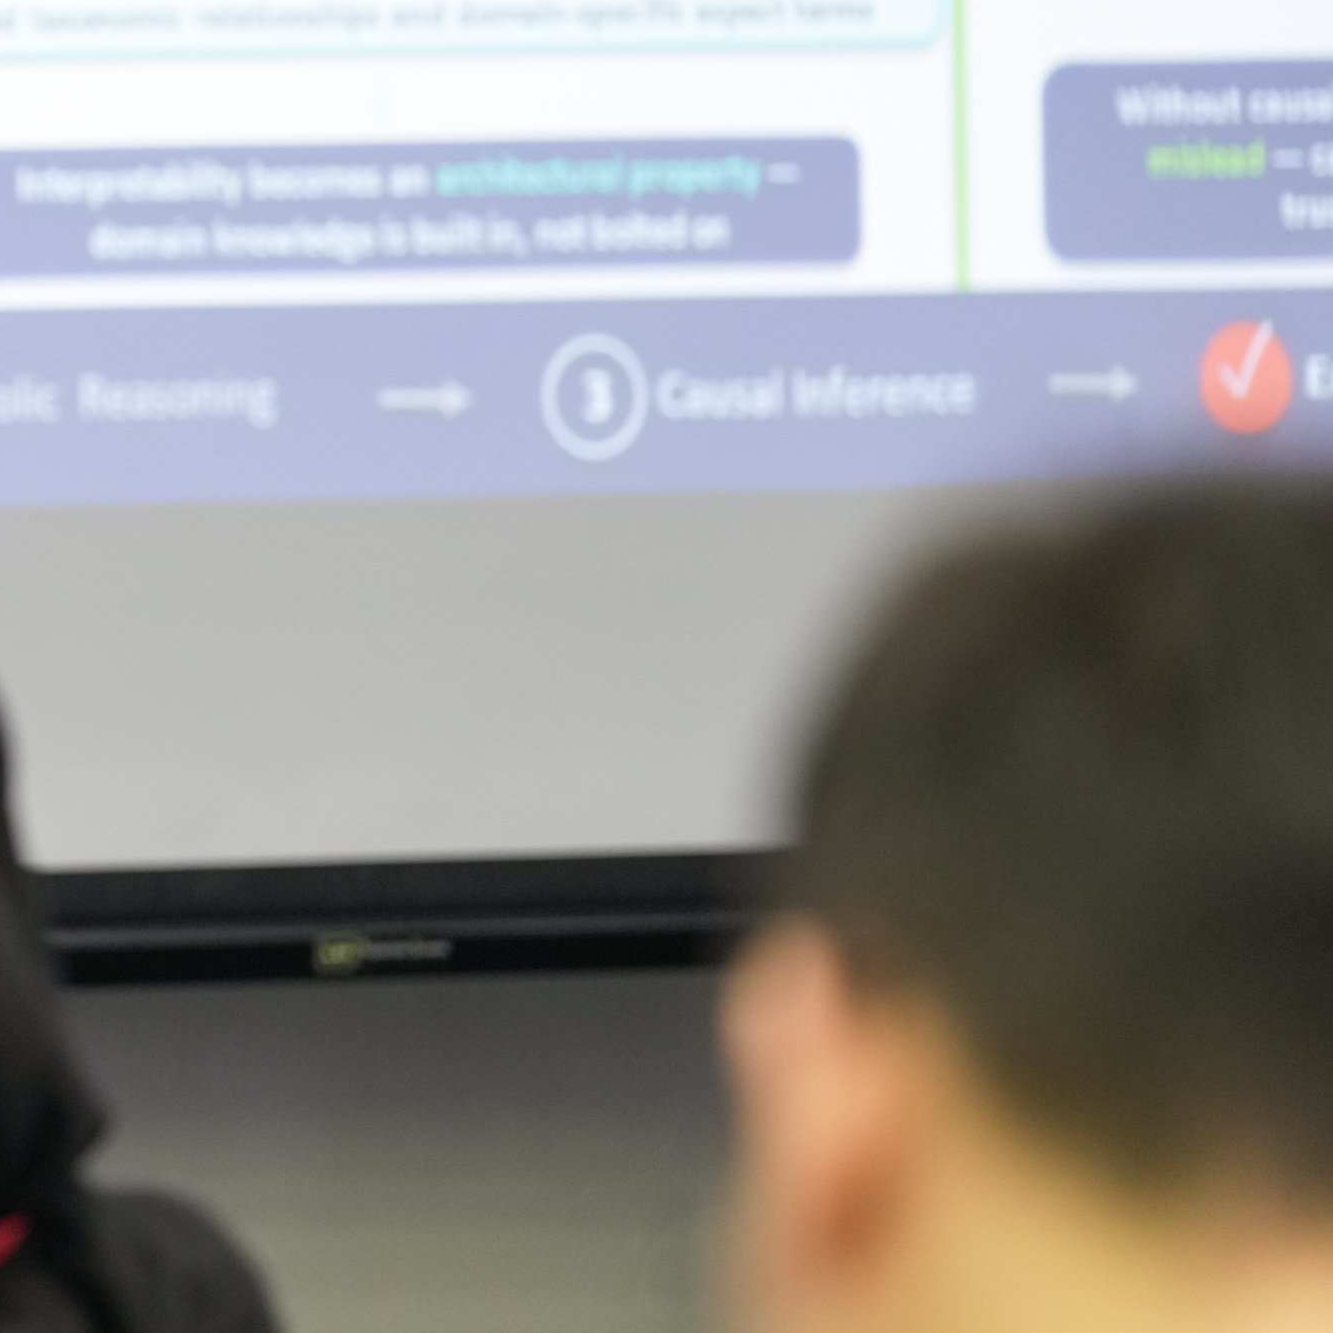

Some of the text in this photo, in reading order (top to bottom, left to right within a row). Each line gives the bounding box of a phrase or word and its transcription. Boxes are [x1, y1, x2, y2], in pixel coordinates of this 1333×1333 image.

[1114, 81, 1242, 127] Without
[14, 158, 242, 211] Interpretability
[247, 156, 383, 201] becomes
[388, 163, 431, 199] an
[435, 152, 625, 198] architectural
[629, 154, 761, 203] property
[87, 216, 209, 262] domain
[211, 213, 375, 266] knowledge
[409, 211, 486, 257] built
[534, 211, 586, 254] not
[587, 207, 689, 254] bolted
[690, 212, 733, 253] on
[76, 369, 279, 431] Reasoning
[579, 362, 976, 425] 3 Causal Inference
